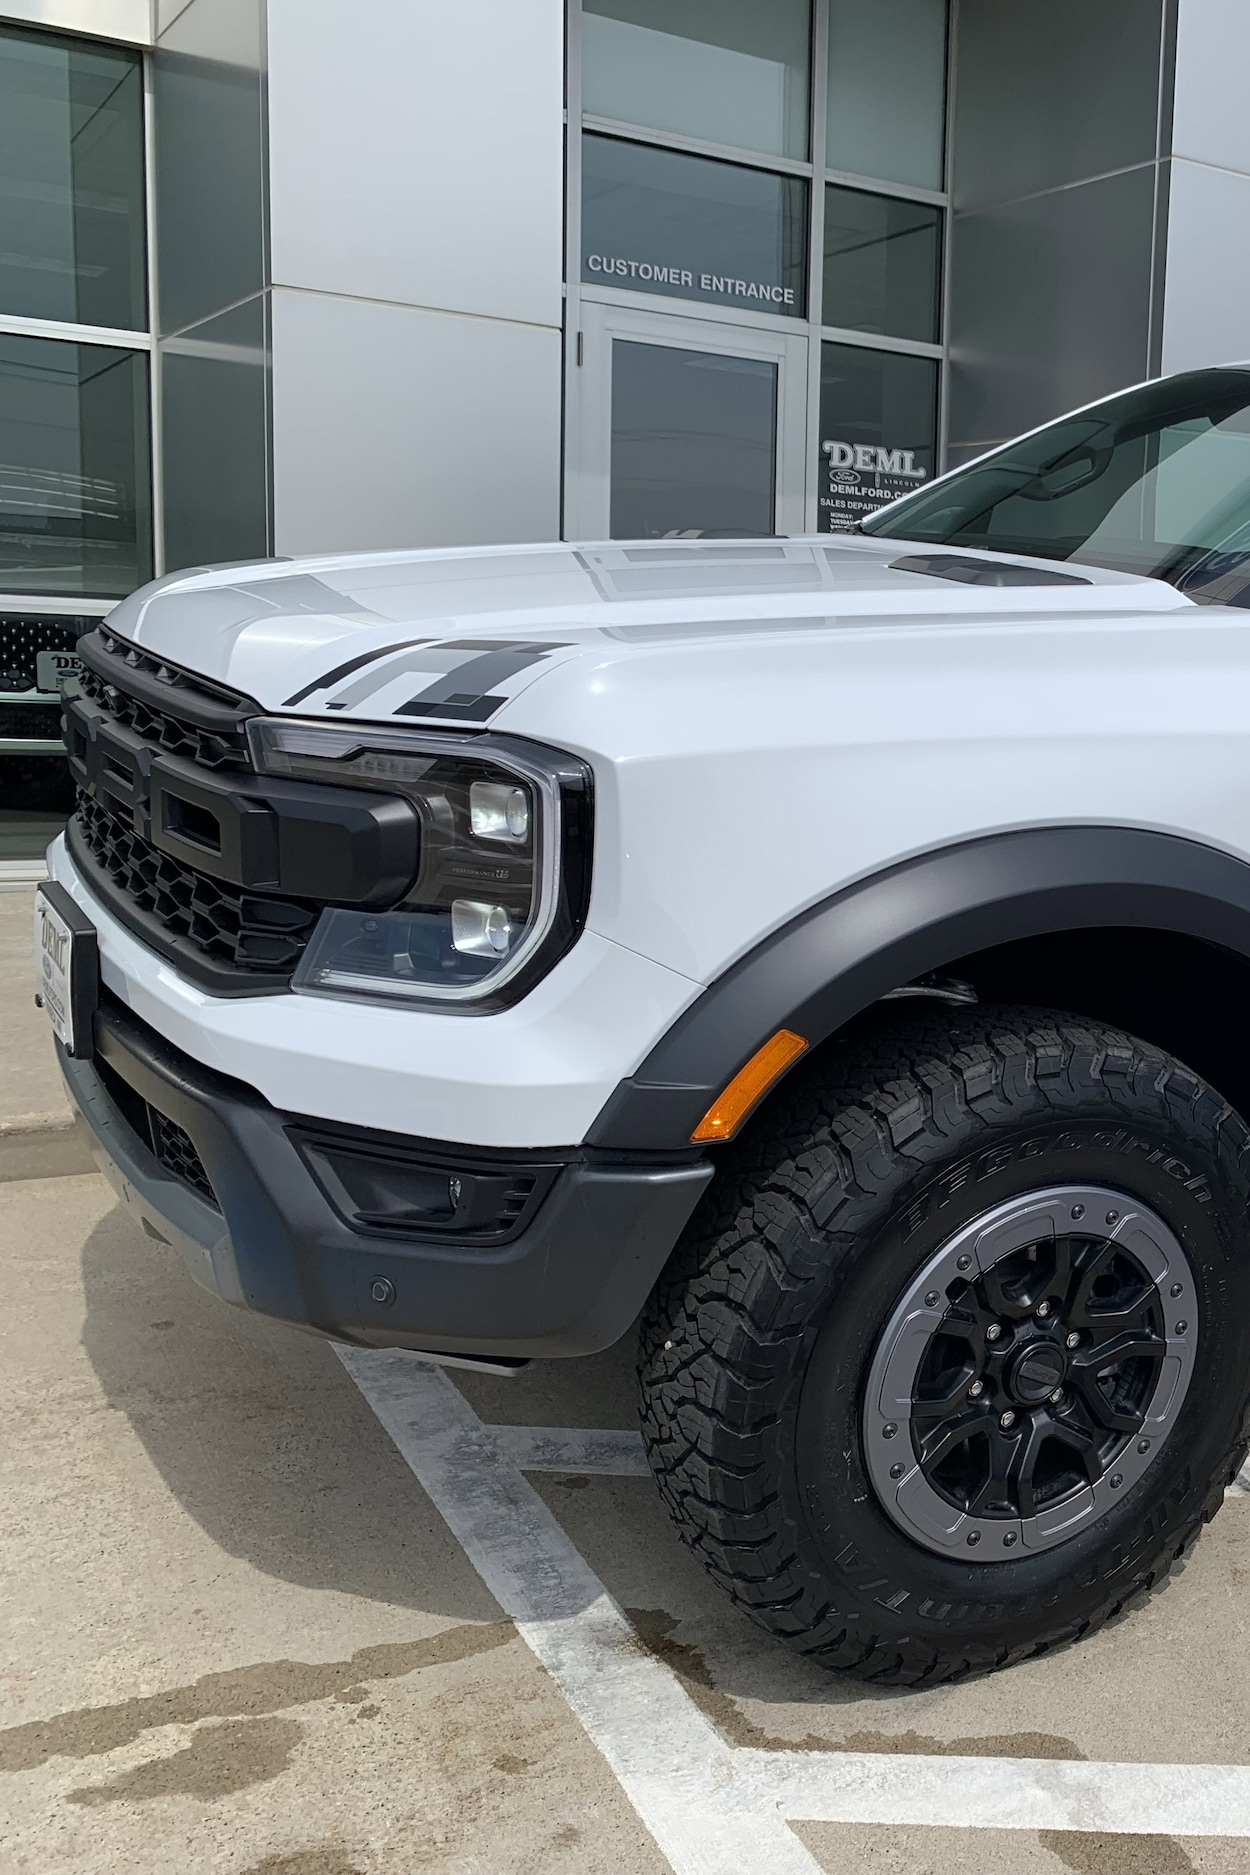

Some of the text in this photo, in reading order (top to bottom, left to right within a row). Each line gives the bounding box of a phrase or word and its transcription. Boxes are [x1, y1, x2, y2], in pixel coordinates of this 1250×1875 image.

[588, 255, 795, 304] CUSTOMER ENTRANCE
[822, 440, 926, 478] DEML
[884, 479, 920, 487] LINCOLN
[820, 498, 847, 509] SALES
[452, 867, 509, 879] PERFORMANCE LED
